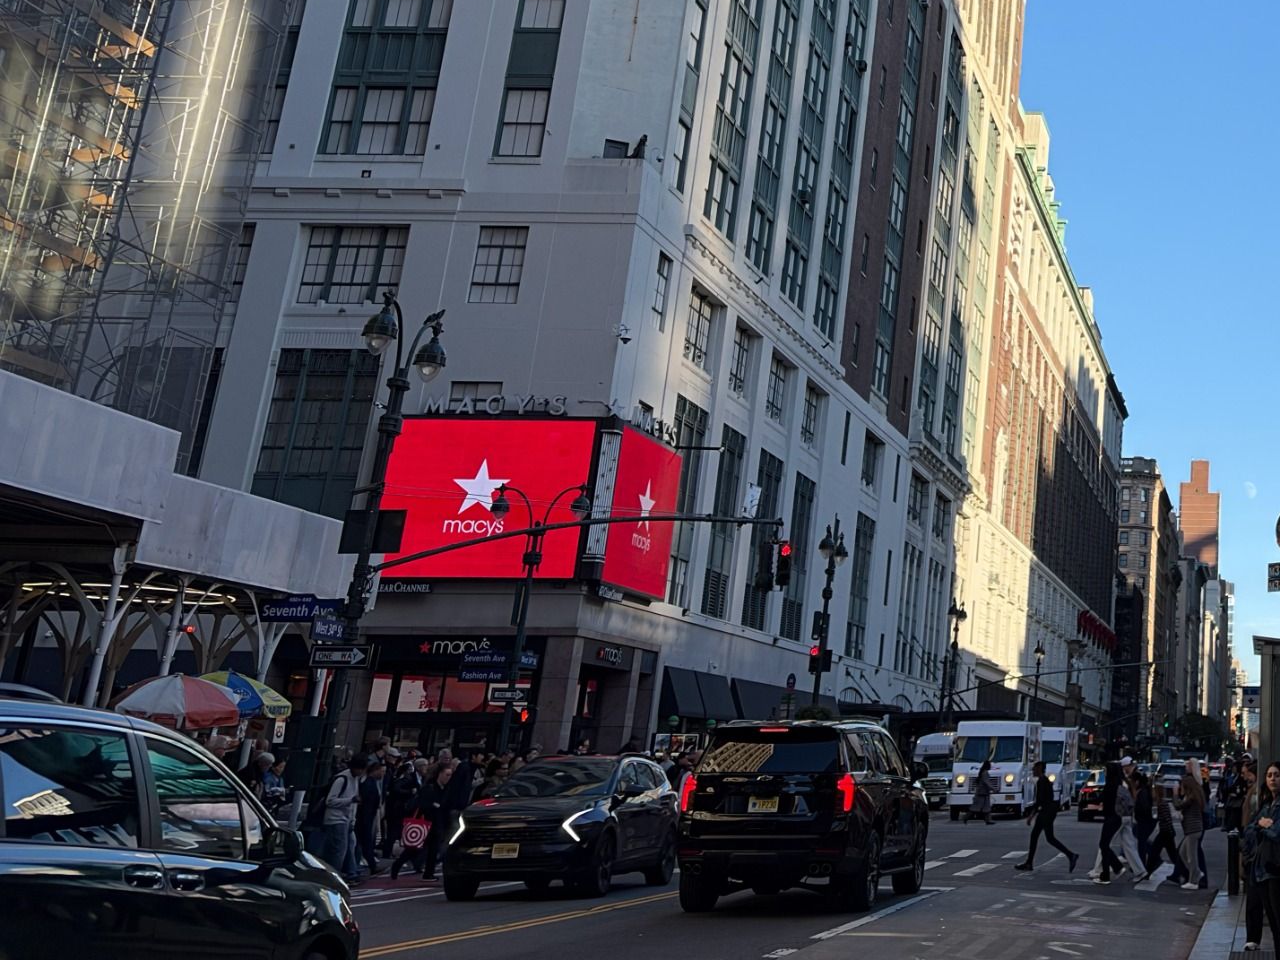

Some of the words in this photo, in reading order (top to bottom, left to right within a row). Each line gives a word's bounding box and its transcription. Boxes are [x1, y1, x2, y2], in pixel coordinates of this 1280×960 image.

[262, 604, 309, 617] Seventh
[341, 652, 358, 660] WAY
[464, 654, 492, 663] Seventh
[493, 654, 506, 663] Ave
[462, 671, 487, 680] Fashion
[489, 672, 502, 680] Ave
